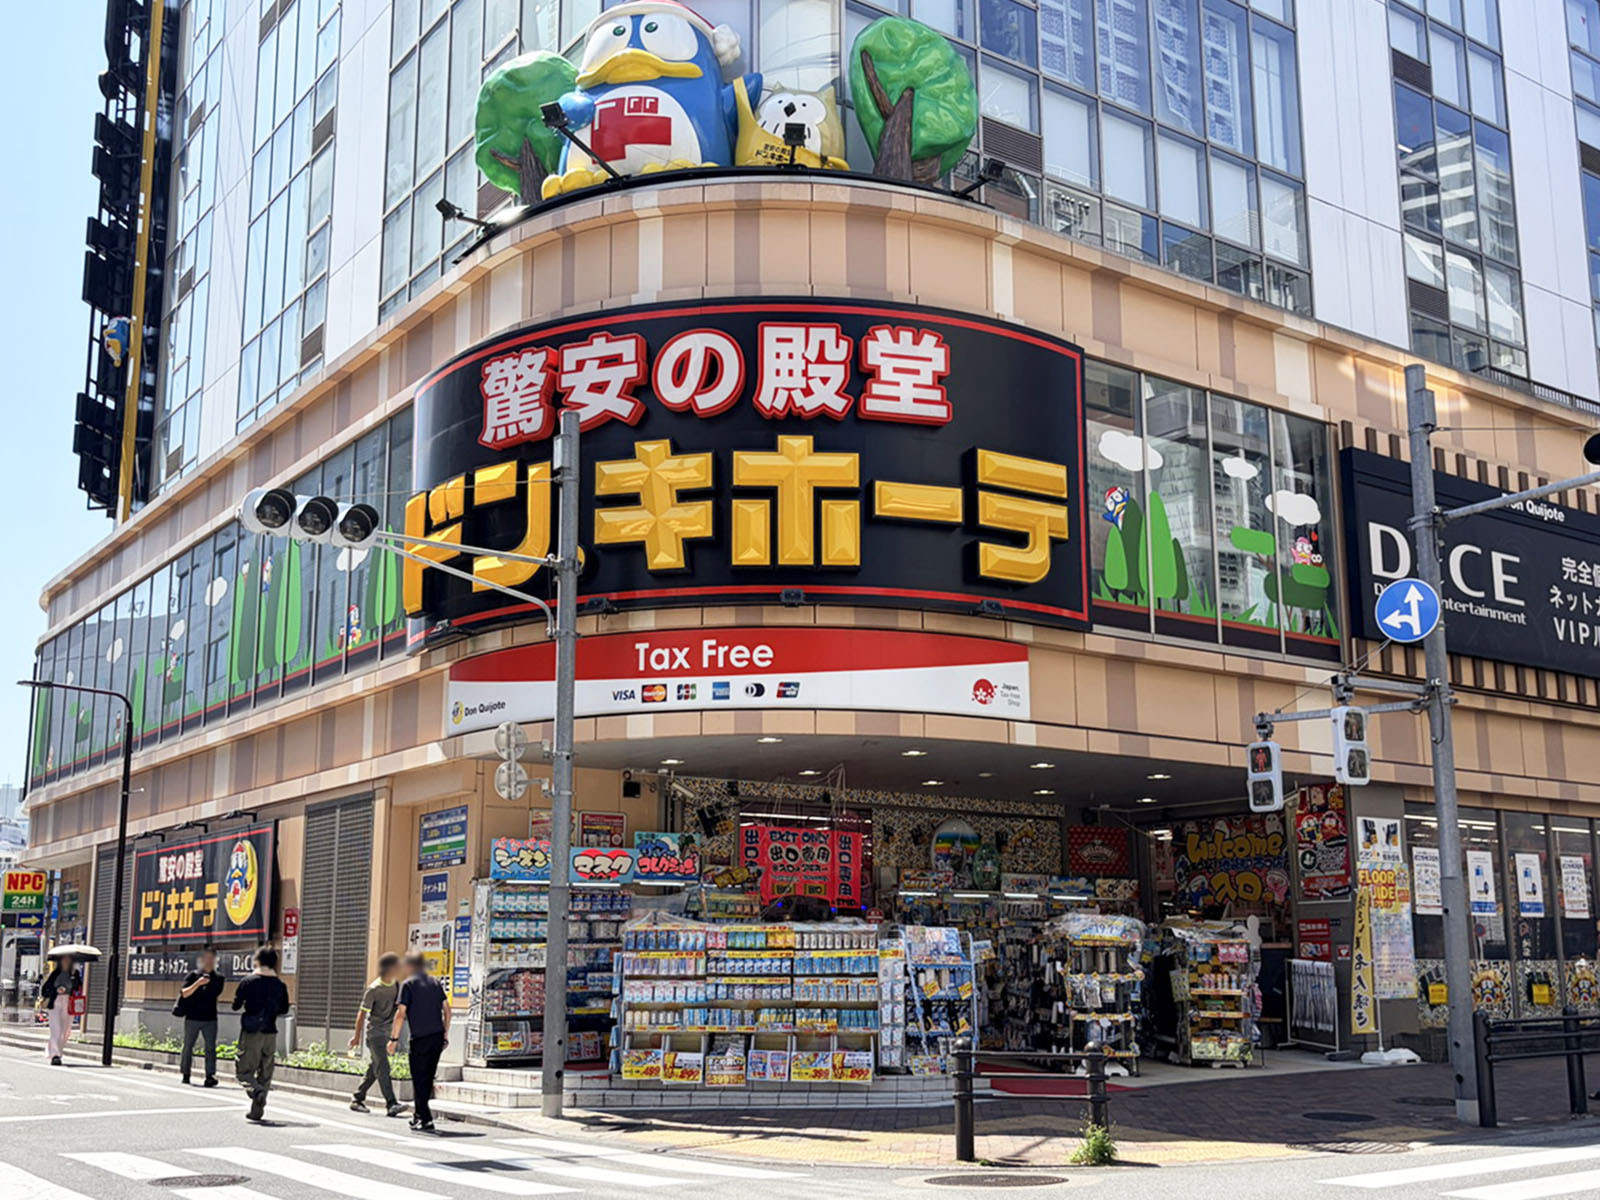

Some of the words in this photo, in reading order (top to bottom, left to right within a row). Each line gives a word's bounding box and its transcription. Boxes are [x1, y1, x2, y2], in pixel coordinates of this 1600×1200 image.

[480, 322, 953, 450] 驚安の殿堂
[1526, 499, 1565, 522] Quijote
[1368, 521, 1526, 607] DCE
[1440, 598, 1527, 625] ntertainment
[635, 642, 691, 671] Tax
[701, 639, 774, 669] Free
[612, 689, 636, 701] VISA
[464, 707, 477, 717] Don
[478, 701, 506, 713] Quijote
[769, 830, 799, 843] EXIT
[801, 831, 830, 844] ONLY
[1186, 829, 1283, 863] Welcome
[493, 847, 552, 869] シーズン
[573, 855, 634, 875] マスク
[7, 873, 44, 891] NPC
[1358, 869, 1396, 884] FLOOR
[12, 896, 37, 905] 24H
[1369, 885, 1396, 901] UIDE
